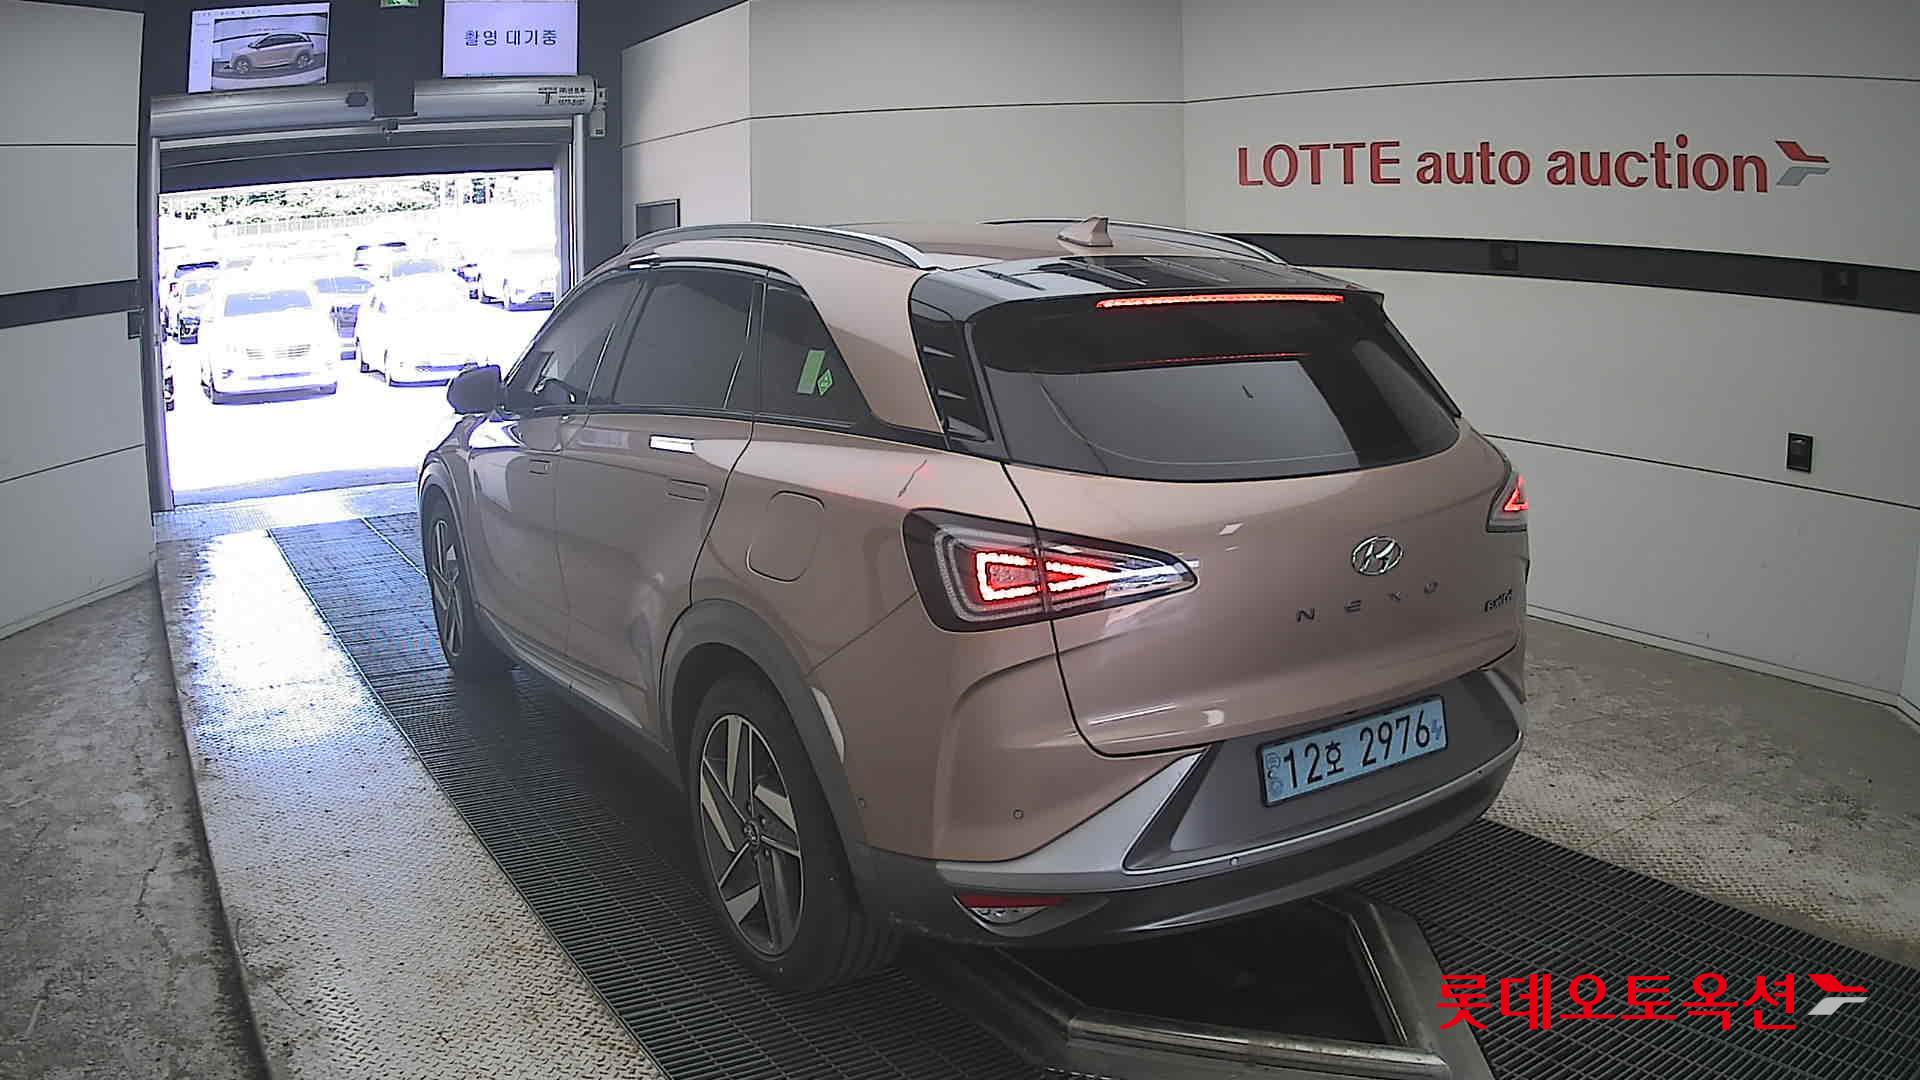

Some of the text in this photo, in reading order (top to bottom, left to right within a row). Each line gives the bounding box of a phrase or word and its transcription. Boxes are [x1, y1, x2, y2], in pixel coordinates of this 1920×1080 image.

[505, 29, 557, 47] 대기중
[1237, 135, 1768, 193] LOTTE auto auction
[1283, 739, 1345, 789] 12호
[1359, 709, 1430, 768] 2976
